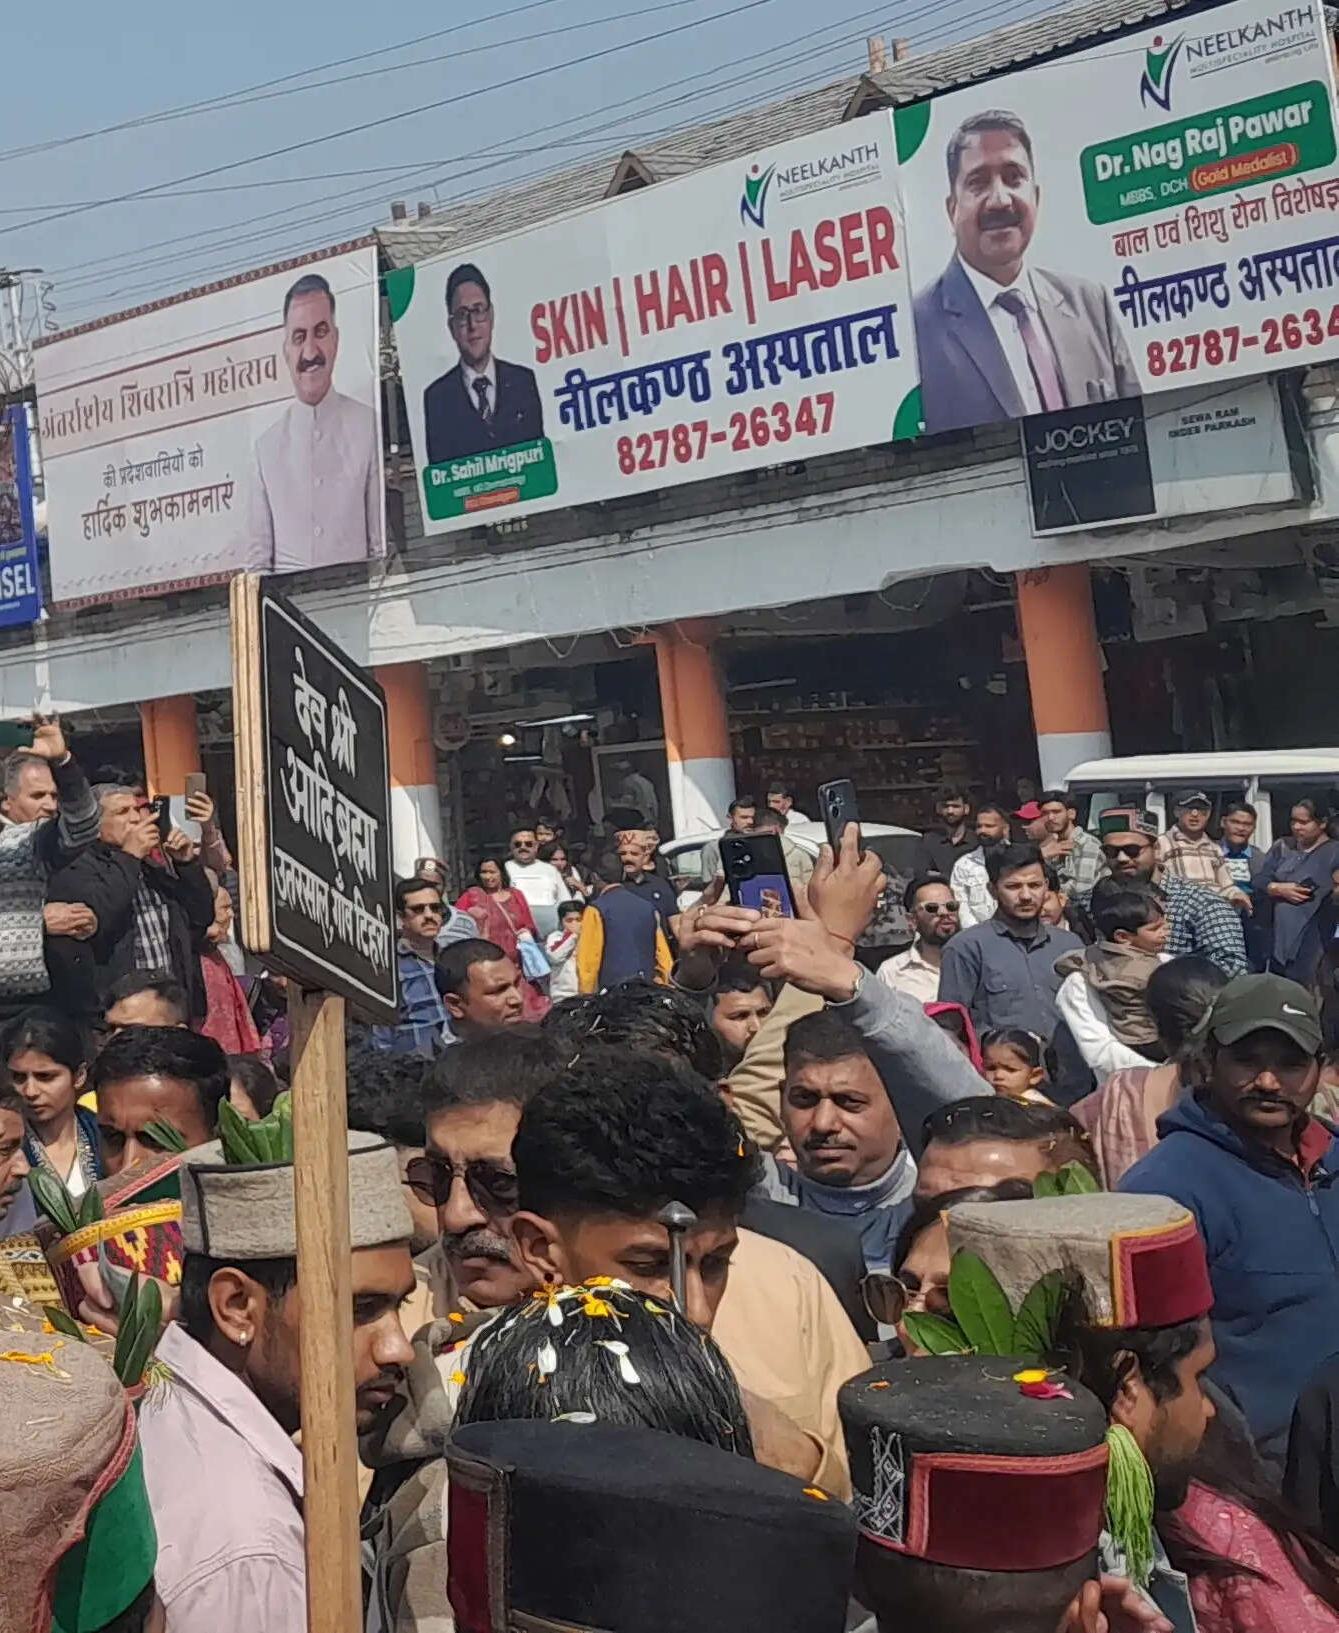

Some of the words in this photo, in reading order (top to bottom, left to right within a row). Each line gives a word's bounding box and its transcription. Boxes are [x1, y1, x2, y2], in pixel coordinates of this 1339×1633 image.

[1185, 5, 1314, 62] NEELKANTH
[1271, 30, 1316, 49] HOSPITAL
[776, 142, 879, 187] NEELKANTH
[1094, 150, 1130, 181] Dr.
[1132, 138, 1183, 170] Nag
[1184, 117, 1228, 156] Raj
[1228, 100, 1314, 144] Pawar
[1160, 175, 1188, 196] DCH
[1112, 226, 1150, 258] बाल
[1153, 213, 1181, 249] एवं
[1184, 205, 1230, 243] शिशु
[1230, 193, 1268, 230] रोग
[530, 286, 609, 364] SKIN
[633, 252, 733, 335] HAIR
[761, 205, 900, 303] LASER
[1113, 263, 1231, 328] नीलकण्ठ
[1237, 235, 1339, 302] अस्पता
[120, 368, 196, 420] शिवरात्रि
[201, 353, 279, 398] महोत्सव
[553, 349, 712, 432] नीलकण्ठ
[721, 303, 900, 396] अस्पताल
[617, 391, 836, 476] 82787-26347
[1034, 416, 1134, 455] JOCKEY
[1181, 413, 1213, 426] SEWA
[1215, 406, 1240, 421] RAM
[102, 463, 117, 488] की
[119, 448, 185, 486] प्रदेशवासियों
[187, 442, 204, 469] को
[431, 468, 452, 486] Dr.
[451, 456, 484, 481] Sahil
[484, 440, 545, 474] Mrigpuri
[80, 492, 127, 541] हार्दिक
[131, 472, 235, 538] शुभकामनाएं
[291, 646, 327, 752] देव
[331, 686, 357, 779] श्री
[279, 745, 340, 870] आदि
